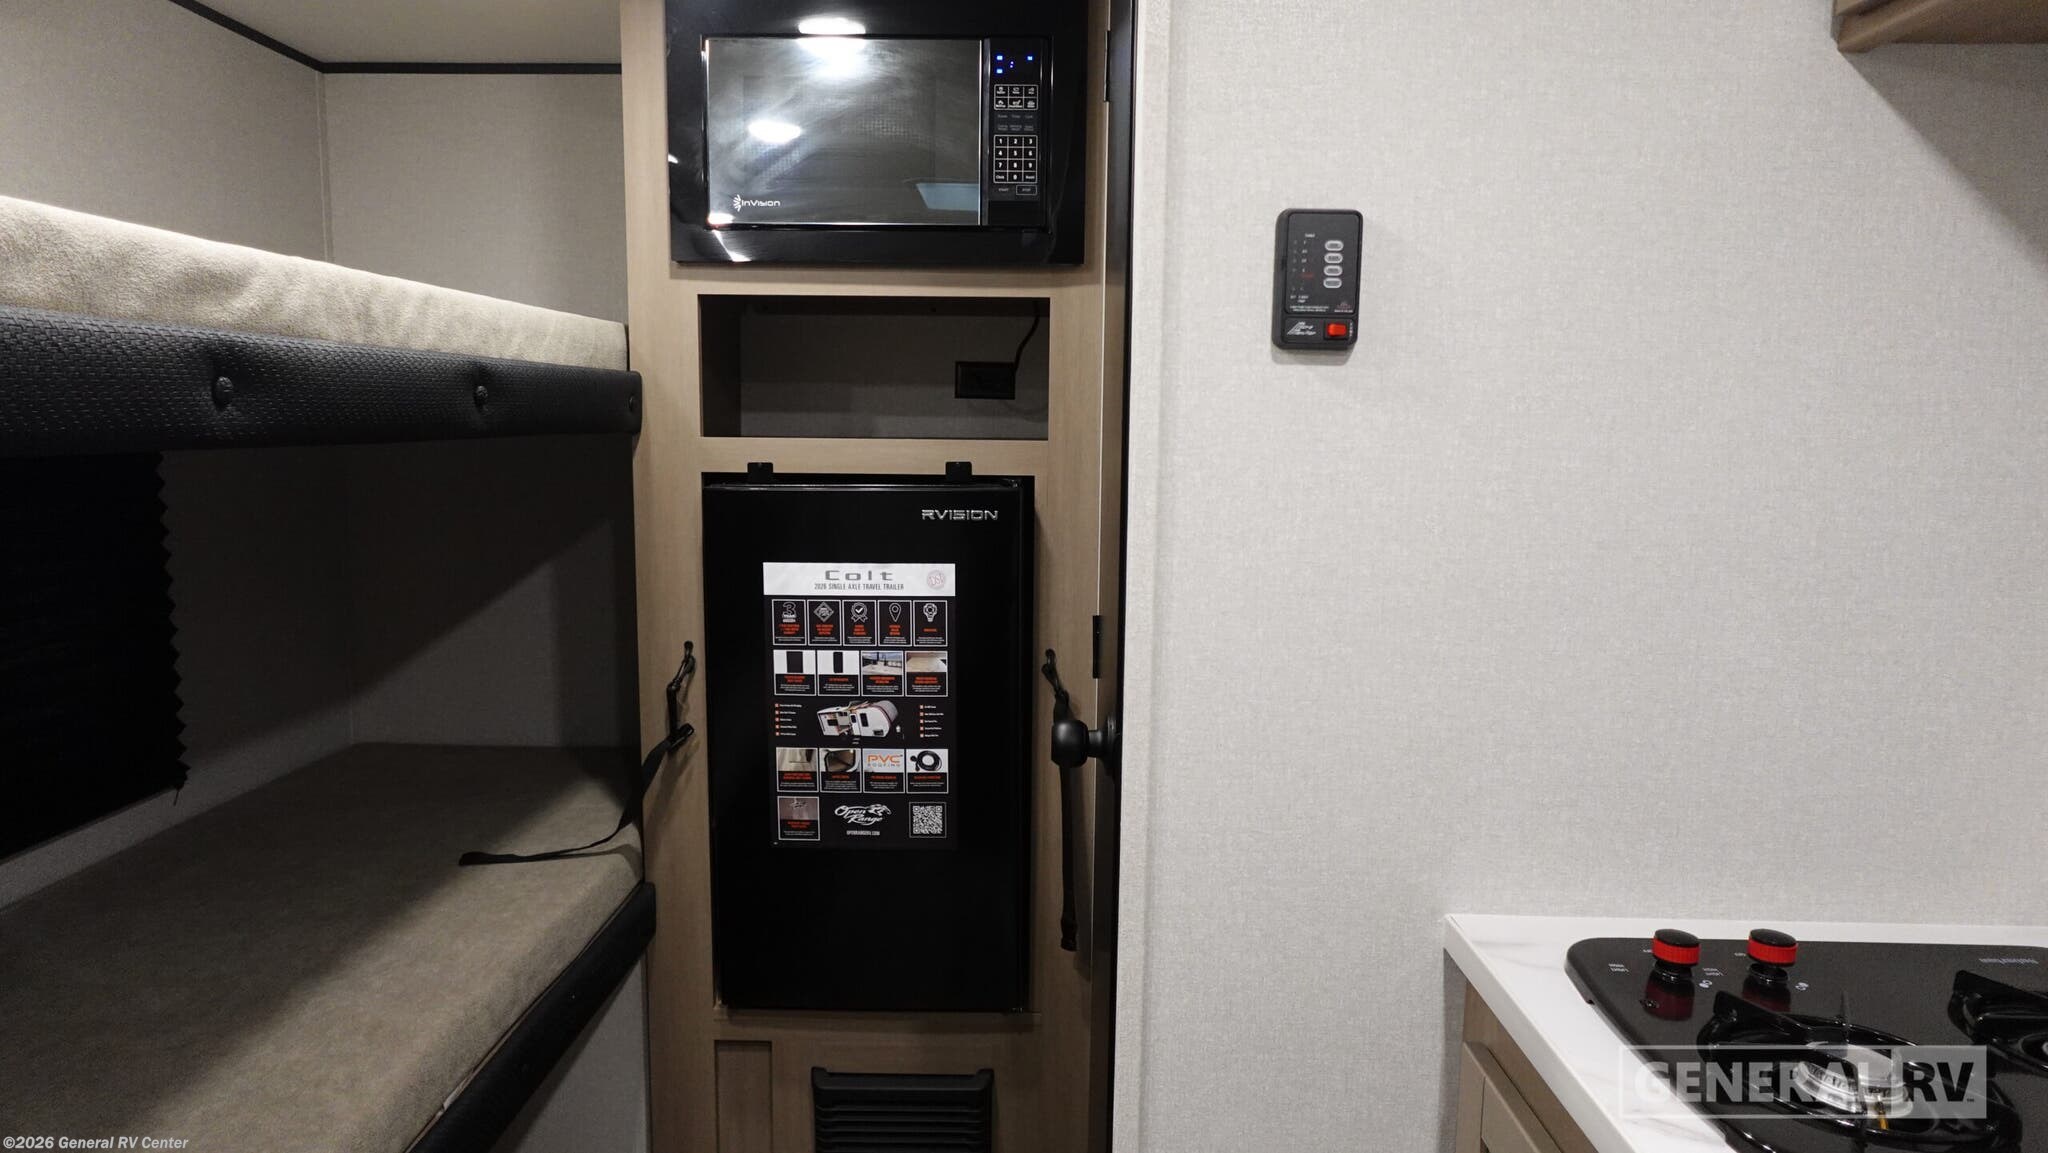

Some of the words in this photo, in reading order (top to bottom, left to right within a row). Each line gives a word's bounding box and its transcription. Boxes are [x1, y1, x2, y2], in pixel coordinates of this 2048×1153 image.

[741, 199, 781, 207] InVision
[921, 509, 999, 520] RVISION
[824, 569, 893, 581] Colt
[848, 583, 861, 591] AXLE
[862, 583, 881, 591] TRAVEL
[883, 583, 904, 591] TRAILER
[867, 754, 900, 763] PVC
[834, 805, 866, 819] Open
[847, 813, 883, 825] Range
